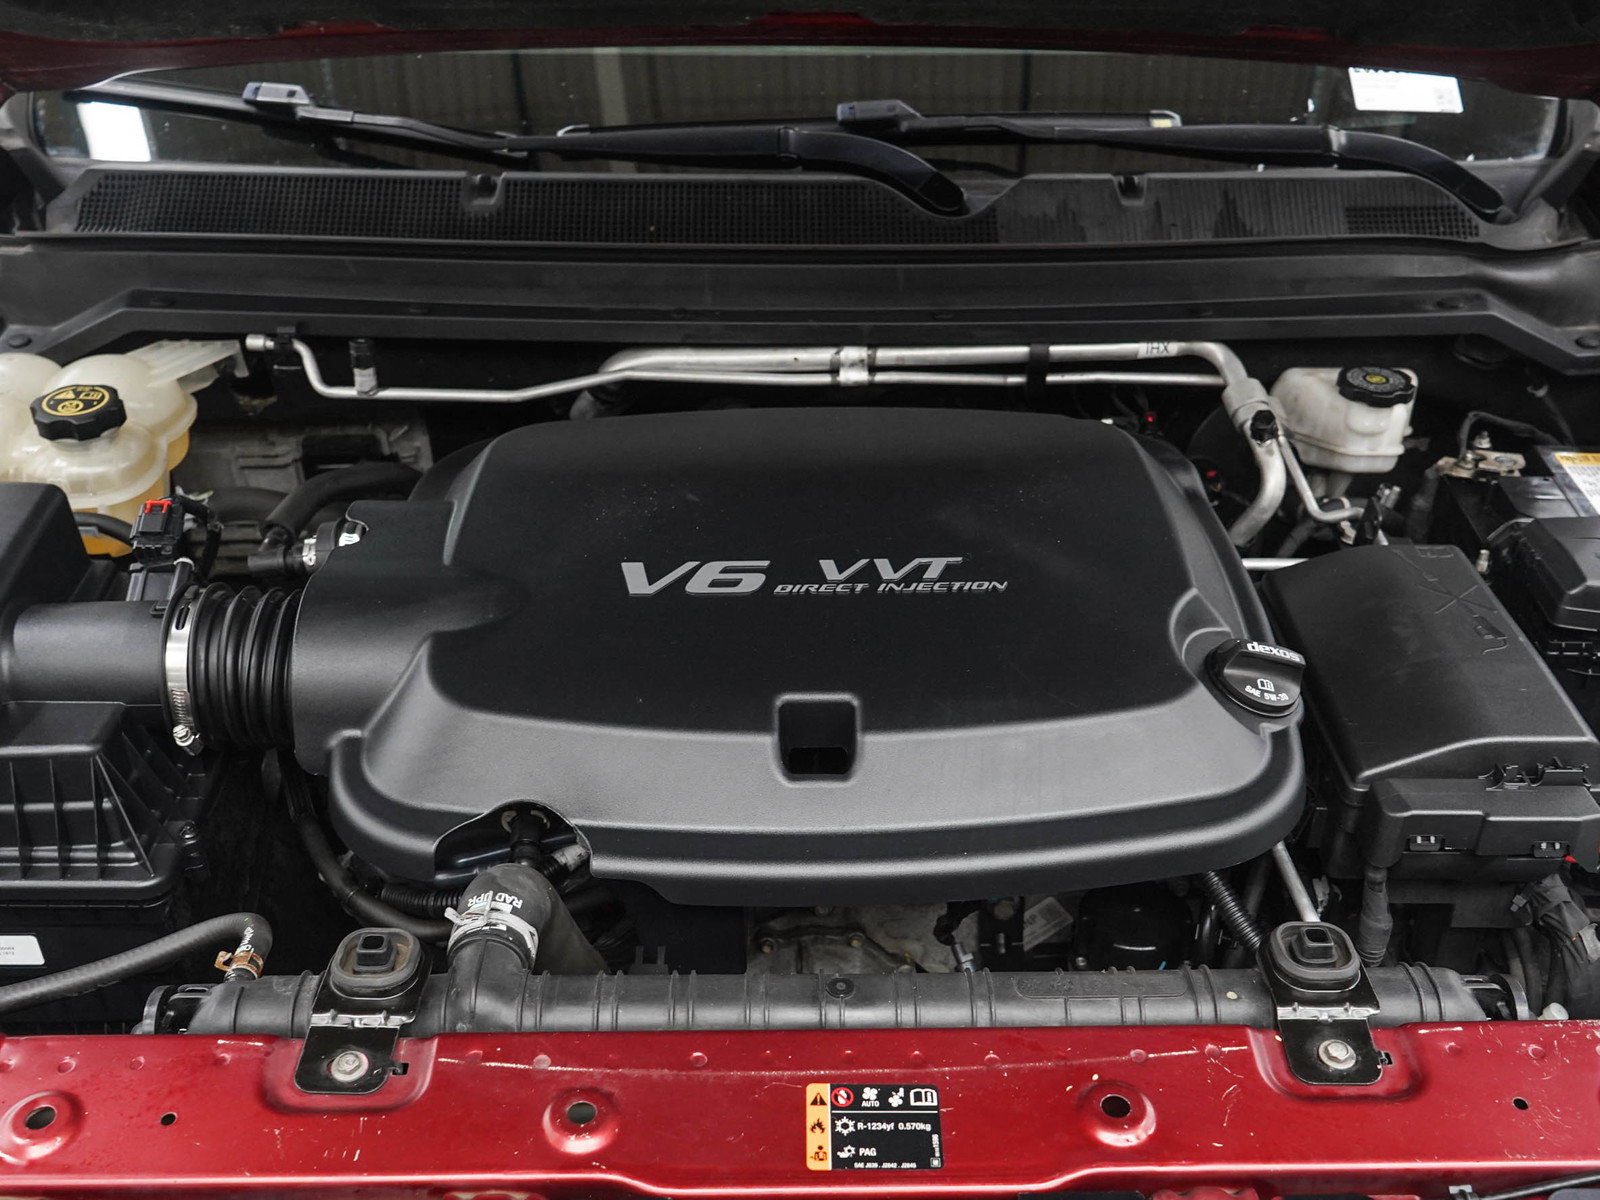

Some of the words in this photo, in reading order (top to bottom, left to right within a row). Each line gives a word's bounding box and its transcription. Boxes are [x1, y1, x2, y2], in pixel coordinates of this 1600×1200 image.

[1146, 342, 1169, 355] IHX
[621, 560, 771, 594] V6
[819, 557, 963, 581] VVT
[774, 583, 870, 594] DIRECT
[877, 581, 1008, 593] INJECTION
[1247, 642, 1300, 662] dexos
[1245, 685, 1261, 698] SAE
[495, 892, 523, 909] RAD
[861, 1100, 880, 1108] AUTO
[857, 1122, 894, 1132] R-1234yf
[898, 1122, 932, 1132] 0.570kg
[859, 1148, 877, 1156] PAG
